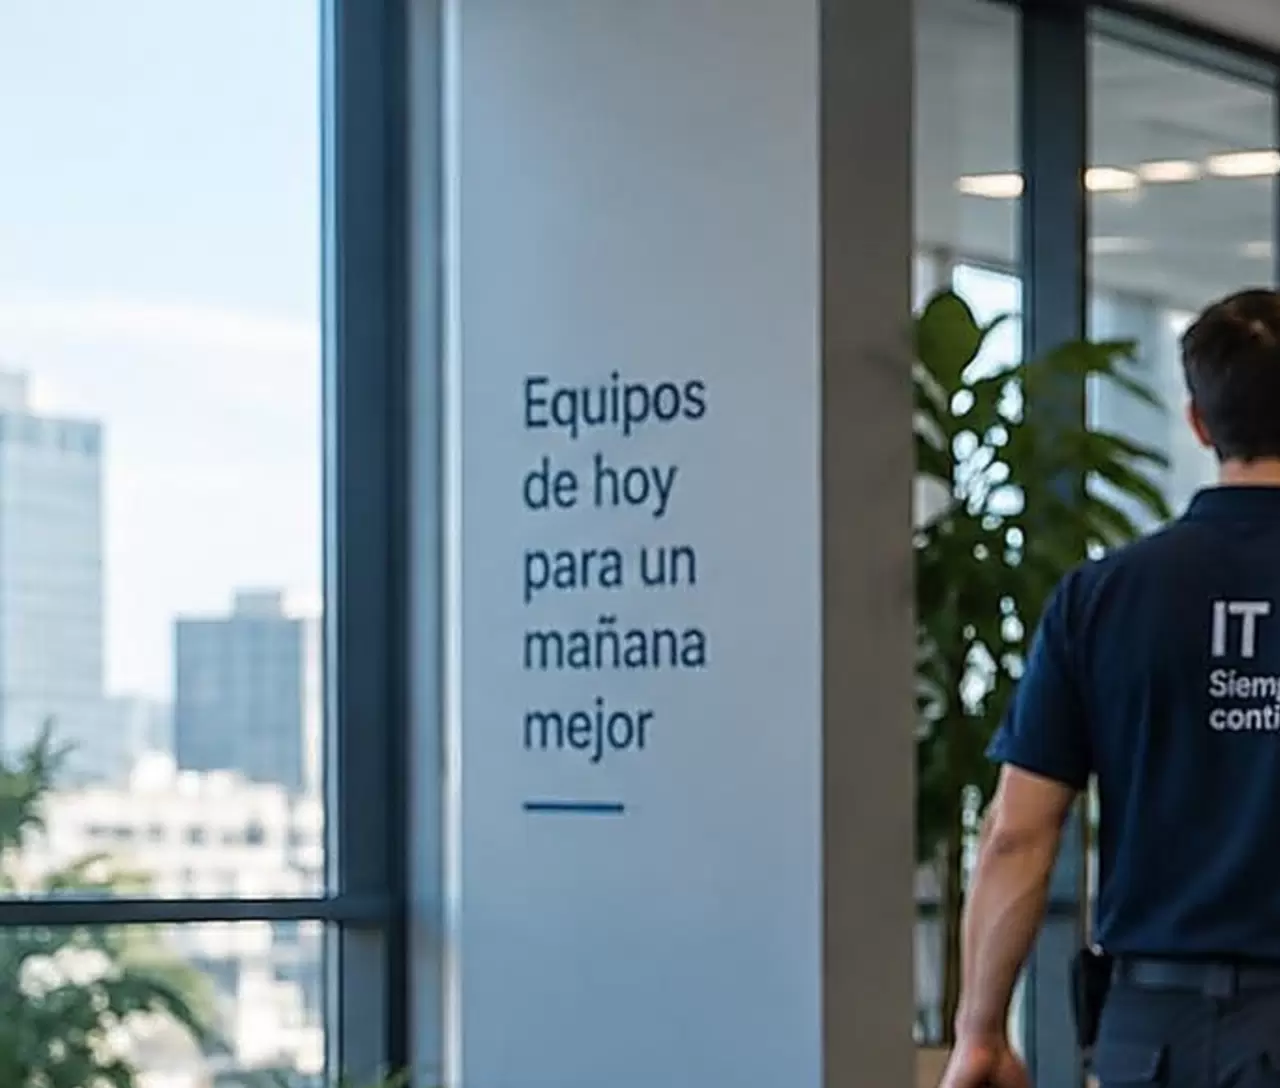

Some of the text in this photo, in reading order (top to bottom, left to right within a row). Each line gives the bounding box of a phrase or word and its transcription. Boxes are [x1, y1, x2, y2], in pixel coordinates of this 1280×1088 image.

[525, 371, 706, 439] Equipos
[523, 452, 678, 519] de hoy
[524, 545, 696, 604] para un
[524, 615, 706, 669] mañana
[1212, 601, 1270, 658] IT
[524, 696, 654, 764] mejor
